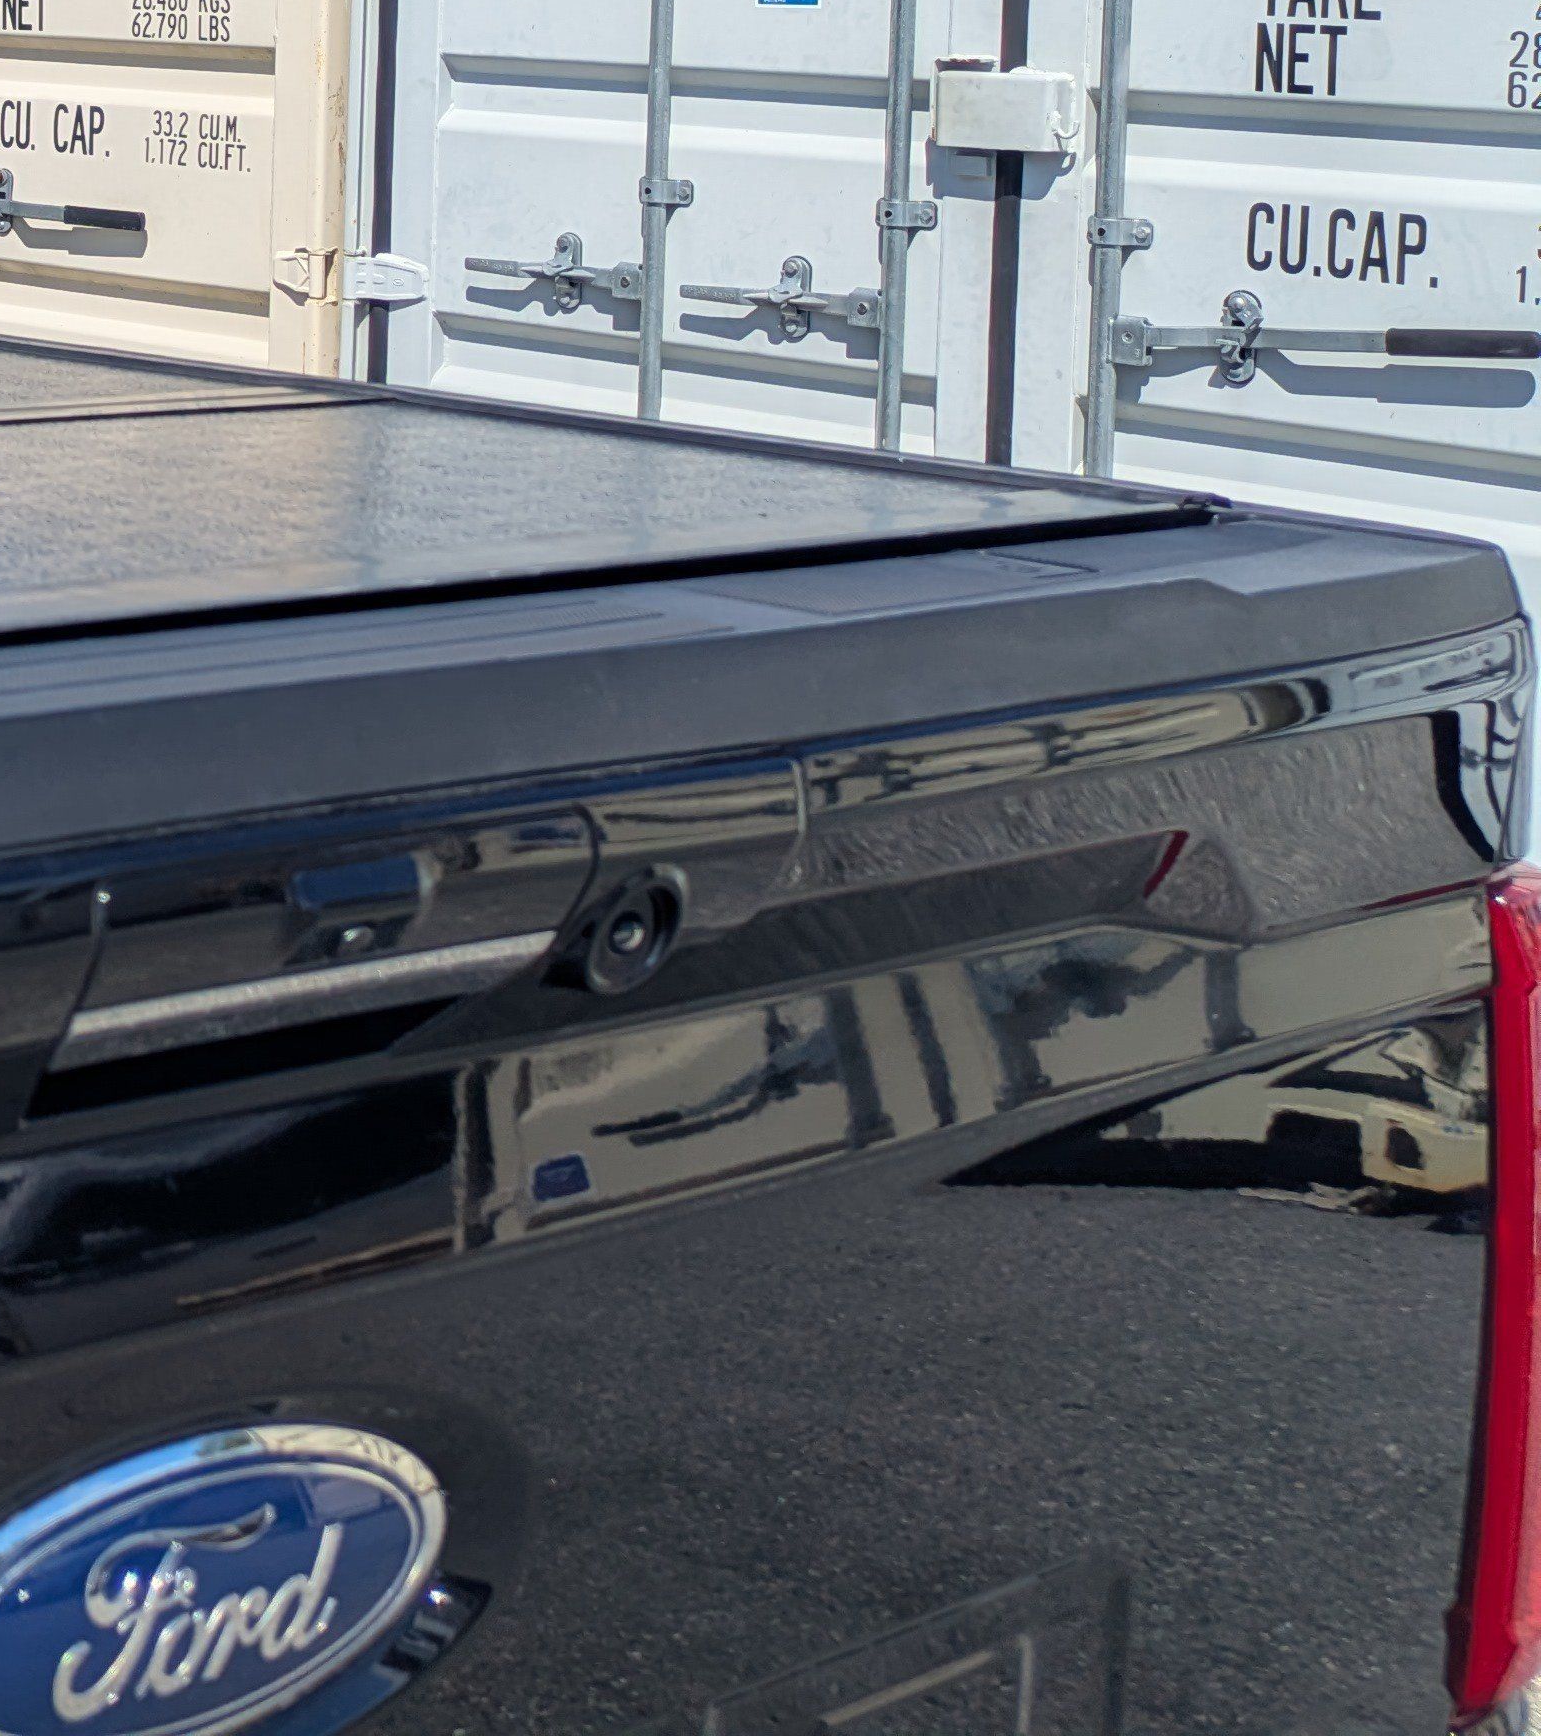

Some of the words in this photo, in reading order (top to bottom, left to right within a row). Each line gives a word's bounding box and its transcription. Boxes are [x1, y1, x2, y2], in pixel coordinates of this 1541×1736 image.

[131, 12, 188, 40] 62,790
[198, 14, 231, 42] LBS
[1255, 22, 1348, 96] NET
[0, 99, 35, 151] CU.
[53, 103, 110, 158] CAP.
[152, 110, 189, 139] 33.2
[199, 113, 241, 143] CU.M.
[144, 136, 188, 167] 1,172
[197, 141, 251, 173] CU.FT.
[52, 1502, 344, 1723] Ford
